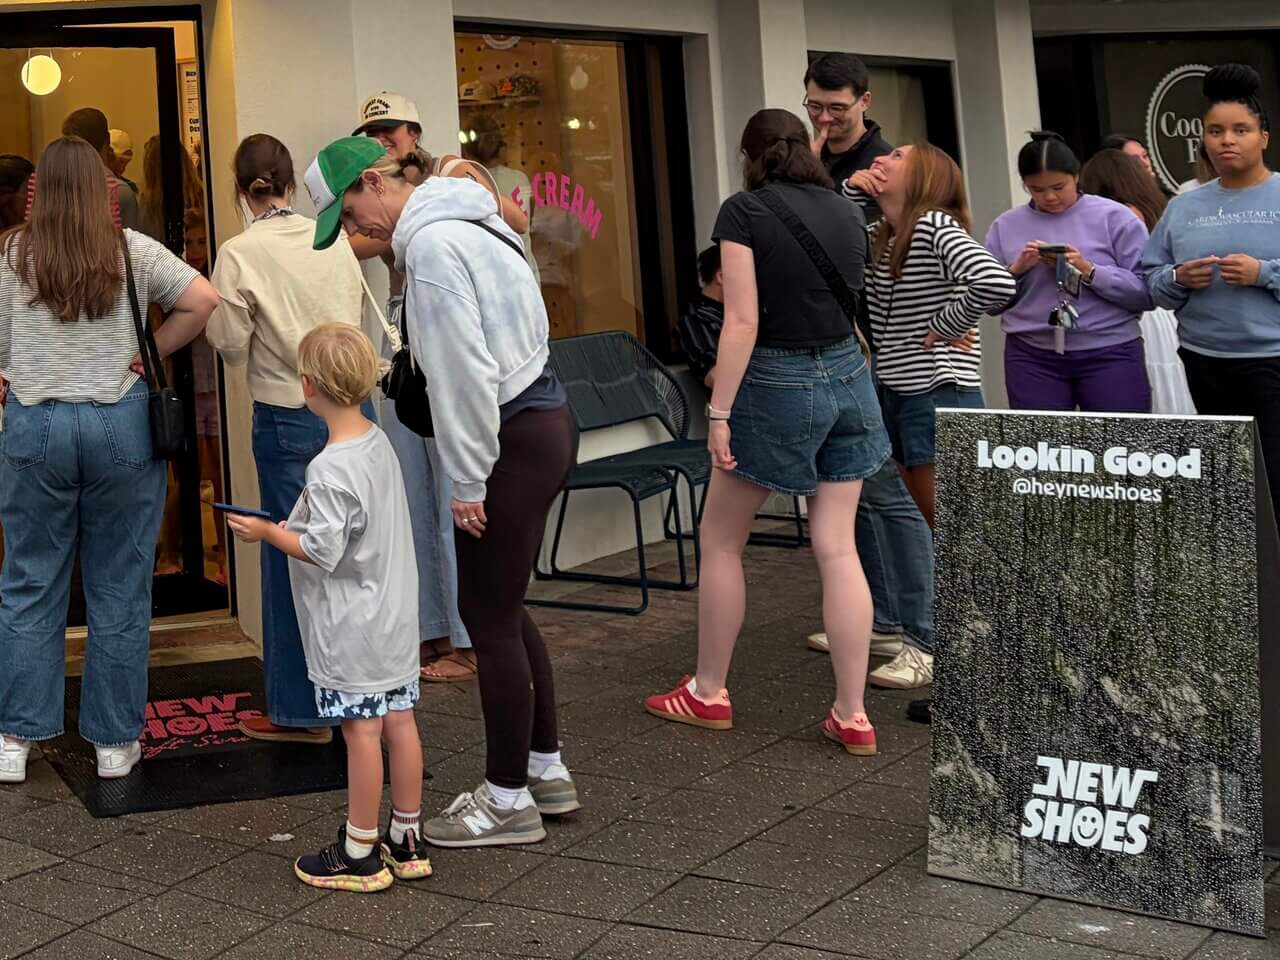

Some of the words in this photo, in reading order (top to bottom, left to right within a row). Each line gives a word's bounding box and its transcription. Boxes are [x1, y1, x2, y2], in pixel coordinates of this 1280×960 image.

[1160, 111, 1203, 138] Coo
[1186, 138, 1200, 164] F
[532, 171, 604, 241] CREAM
[977, 440, 1096, 474] Lookin
[1103, 446, 1202, 480] Good
[1013, 477, 1163, 503] @heynewshoes
[139, 709, 264, 740] HOE
[1032, 755, 1159, 809] NEW
[1020, 798, 1151, 855] SHOES
